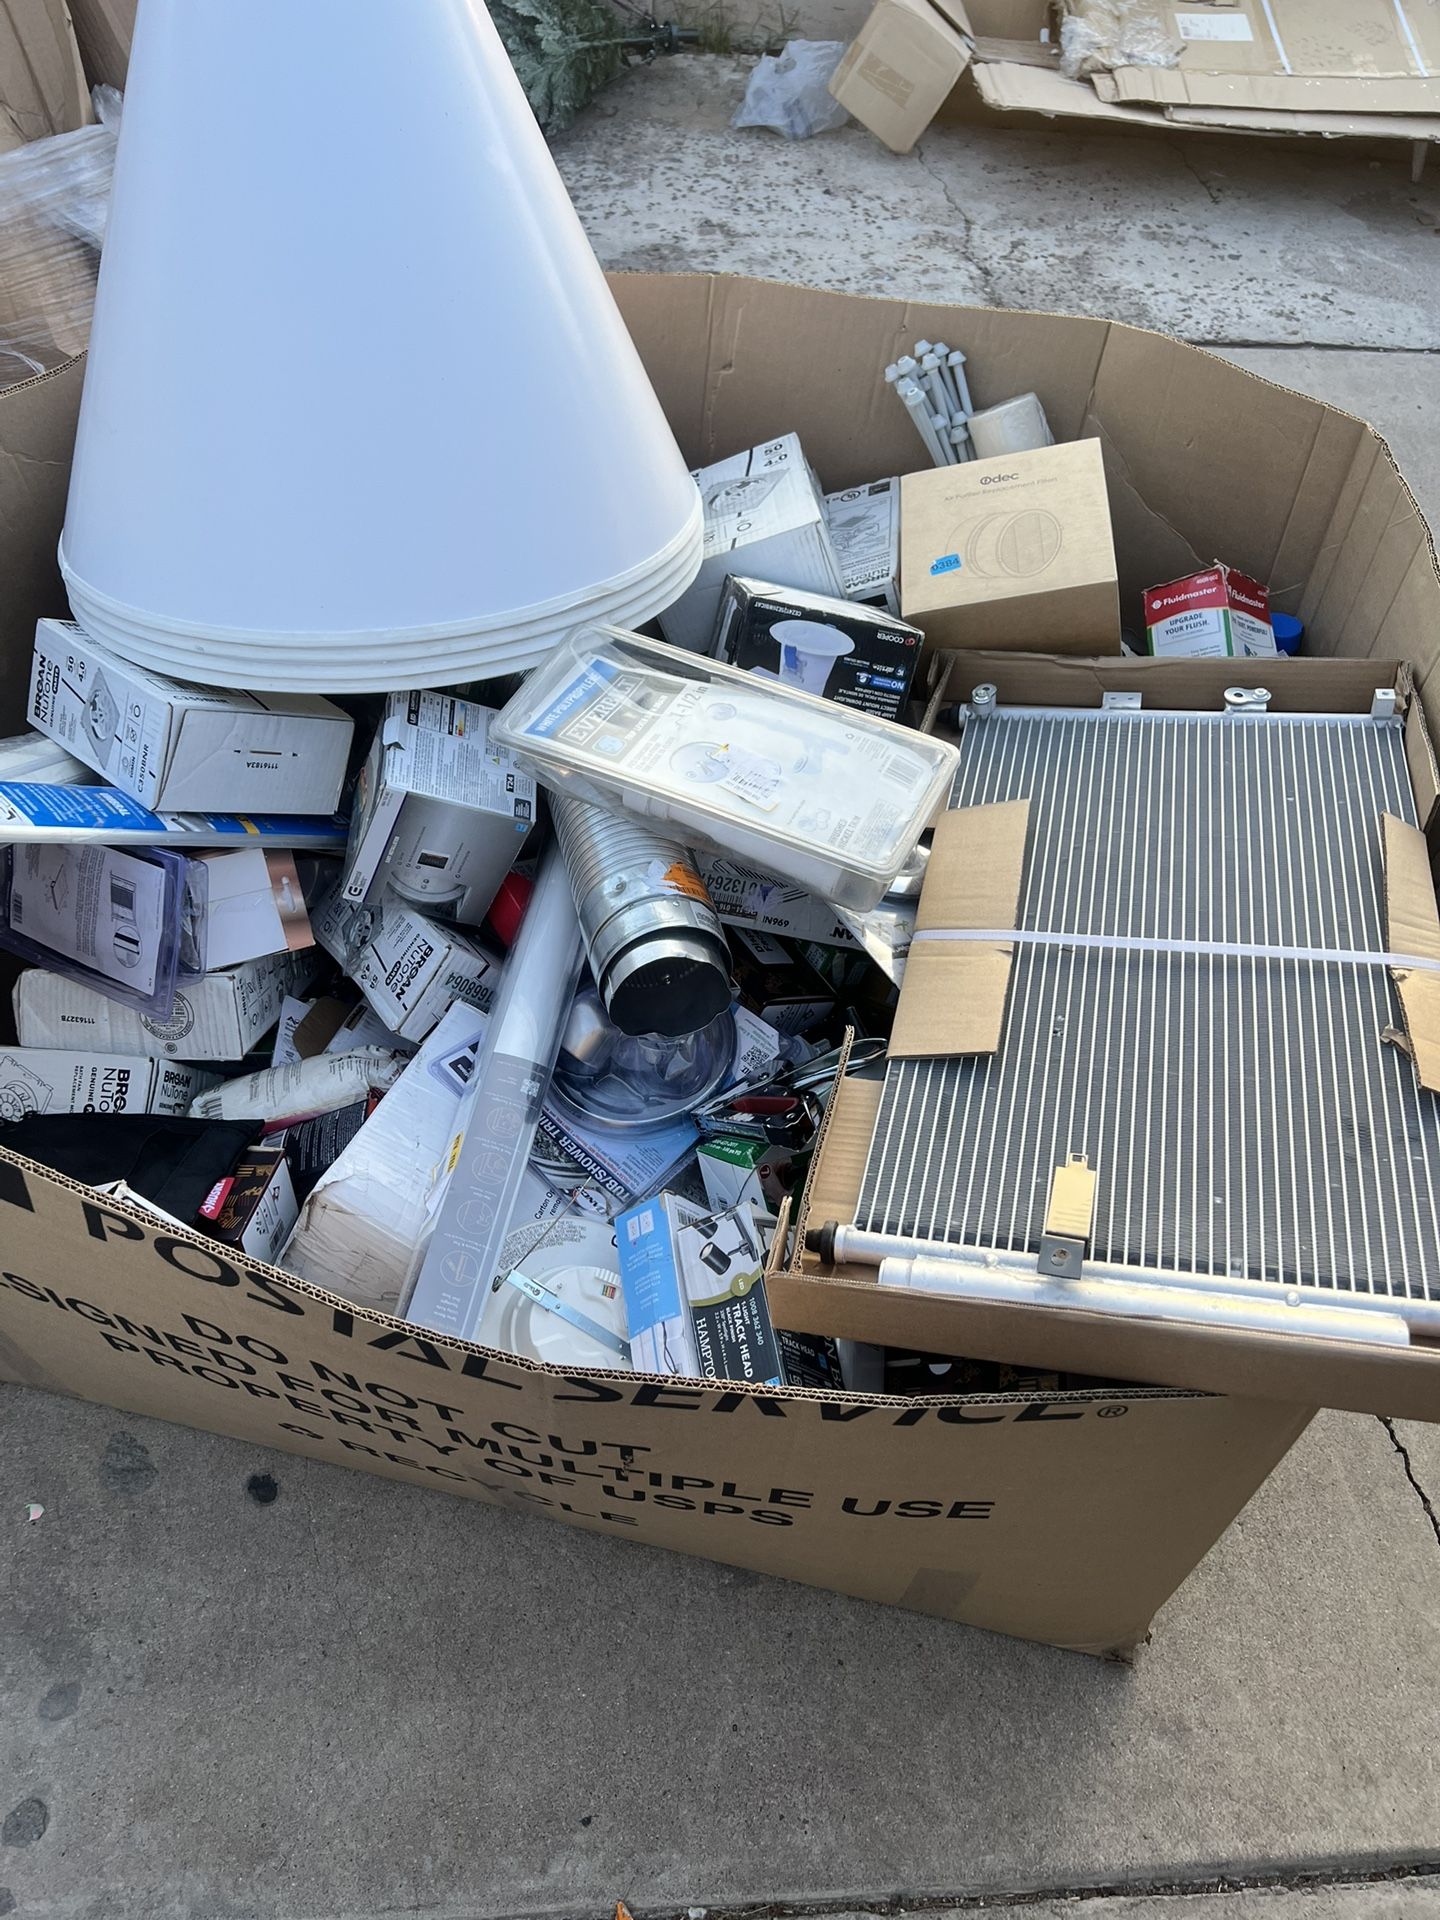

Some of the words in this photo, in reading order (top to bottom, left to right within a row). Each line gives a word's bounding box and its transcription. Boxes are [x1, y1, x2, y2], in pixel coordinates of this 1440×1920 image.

[763, 453, 788, 467] 4.0
[764, 443, 783, 455] 50
[1163, 586, 1218, 607] Fluidmaster
[1164, 623, 1185, 636] YOUR
[1168, 612, 1203, 627] UPGRADE
[877, 631, 905, 645] COOPER
[67, 656, 75, 673] 50
[78, 661, 87, 682] 4.0
[34, 654, 47, 717] BROAN
[40, 660, 54, 723] NuTone
[389, 938, 429, 993] NuTone
[399, 945, 435, 1003] BROAN
[90, 1066, 98, 1104] GENUINE
[99, 1067, 117, 1112] NuTo
[159, 1082, 189, 1100] NuTone
[162, 1070, 193, 1088] BROAN
[539, 1114, 562, 1140] TRI
[558, 1135, 631, 1205] TUB/SHOWER
[534, 1196, 548, 1219] Carton
[740, 1299, 751, 1325] 1-LIGHT
[749, 1296, 758, 1317] 1008
[753, 1317, 761, 1332] 362
[696, 1316, 717, 1380] HAMPTO
[732, 1303, 746, 1340] TRACK
[739, 1343, 754, 1379] HEAD
[756, 1332, 764, 1346] 340
[781, 1335, 800, 1350] TRACK
[798, 1343, 816, 1357] HEAD
[181, 1312, 289, 1367] DO
[310, 1359, 464, 1421] NOT
[490, 1421, 652, 1467] CUT
[99, 1331, 461, 1456] PROPERTY
[484, 1456, 579, 1488] OF
[601, 1485, 795, 1527] USPS
[278, 1369, 423, 1432] FOR
[449, 1429, 815, 1511] MULTIPLE
[841, 1496, 996, 1521] USE
[341, 1437, 641, 1528] RECYCLE
